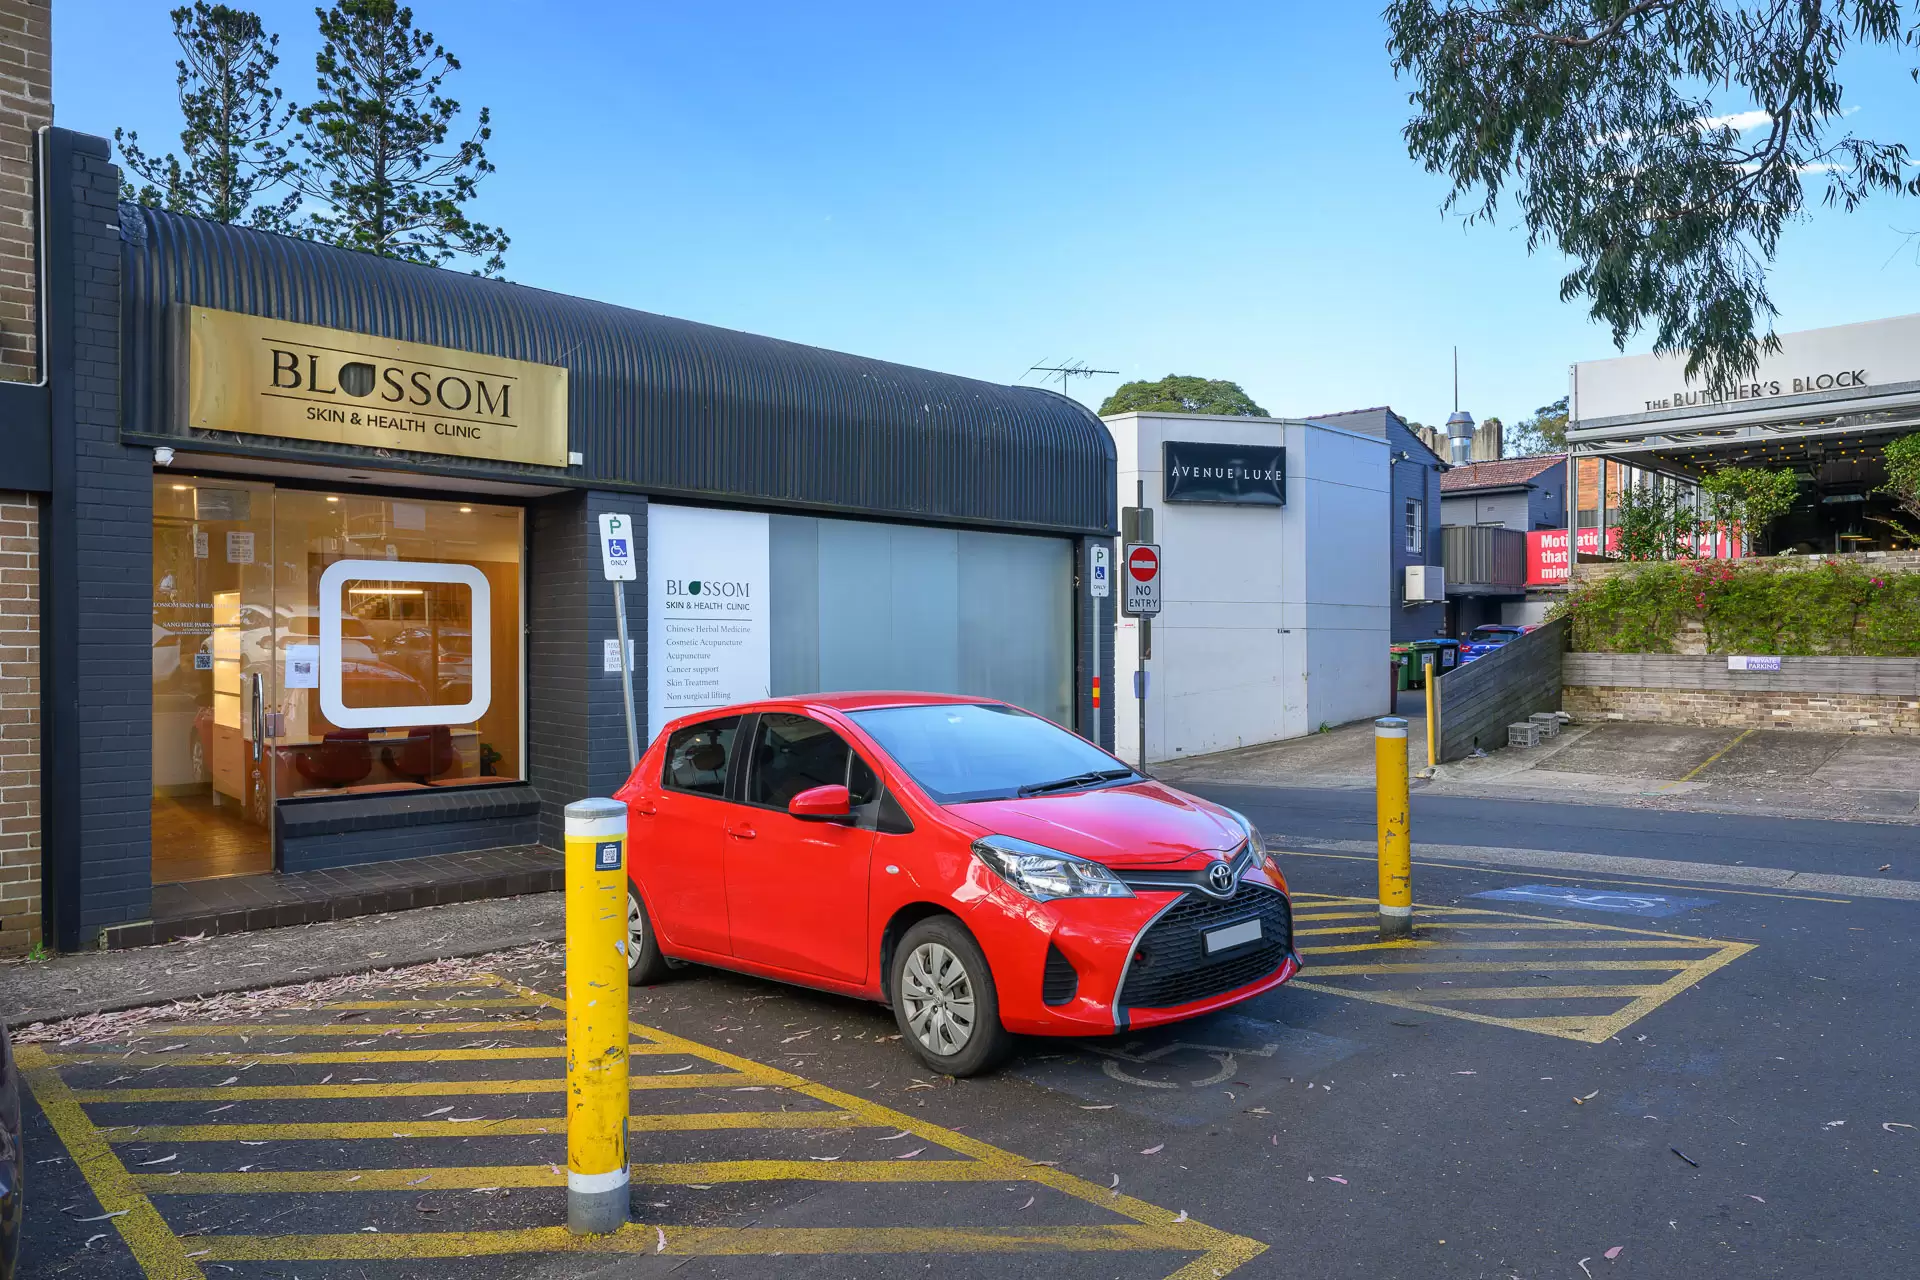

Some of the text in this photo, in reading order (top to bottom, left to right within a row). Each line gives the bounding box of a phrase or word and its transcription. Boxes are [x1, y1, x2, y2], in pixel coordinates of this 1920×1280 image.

[1644, 398, 1669, 411] THE
[1792, 369, 1866, 394] BLOCK
[306, 407, 481, 440] SKIN & HEALTH CLINIC
[1171, 466, 1282, 481] AVENUE LUXE
[609, 519, 622, 535] P
[1096, 551, 1104, 563] P
[1541, 549, 1568, 563] that
[1135, 585, 1152, 596] NO
[665, 601, 750, 611] SKIN & HEALTH CLINIC
[1129, 598, 1158, 608] ENTRY
[666, 624, 751, 633] Chinese Herbal Medicine
[666, 638, 743, 648] Cosmetic Acupuncture
[666, 652, 711, 662] Acupuncture
[666, 665, 720, 675] Cancer support
[666, 678, 719, 687] Skin Treatment
[666, 690, 732, 701] Non surgical lifting
